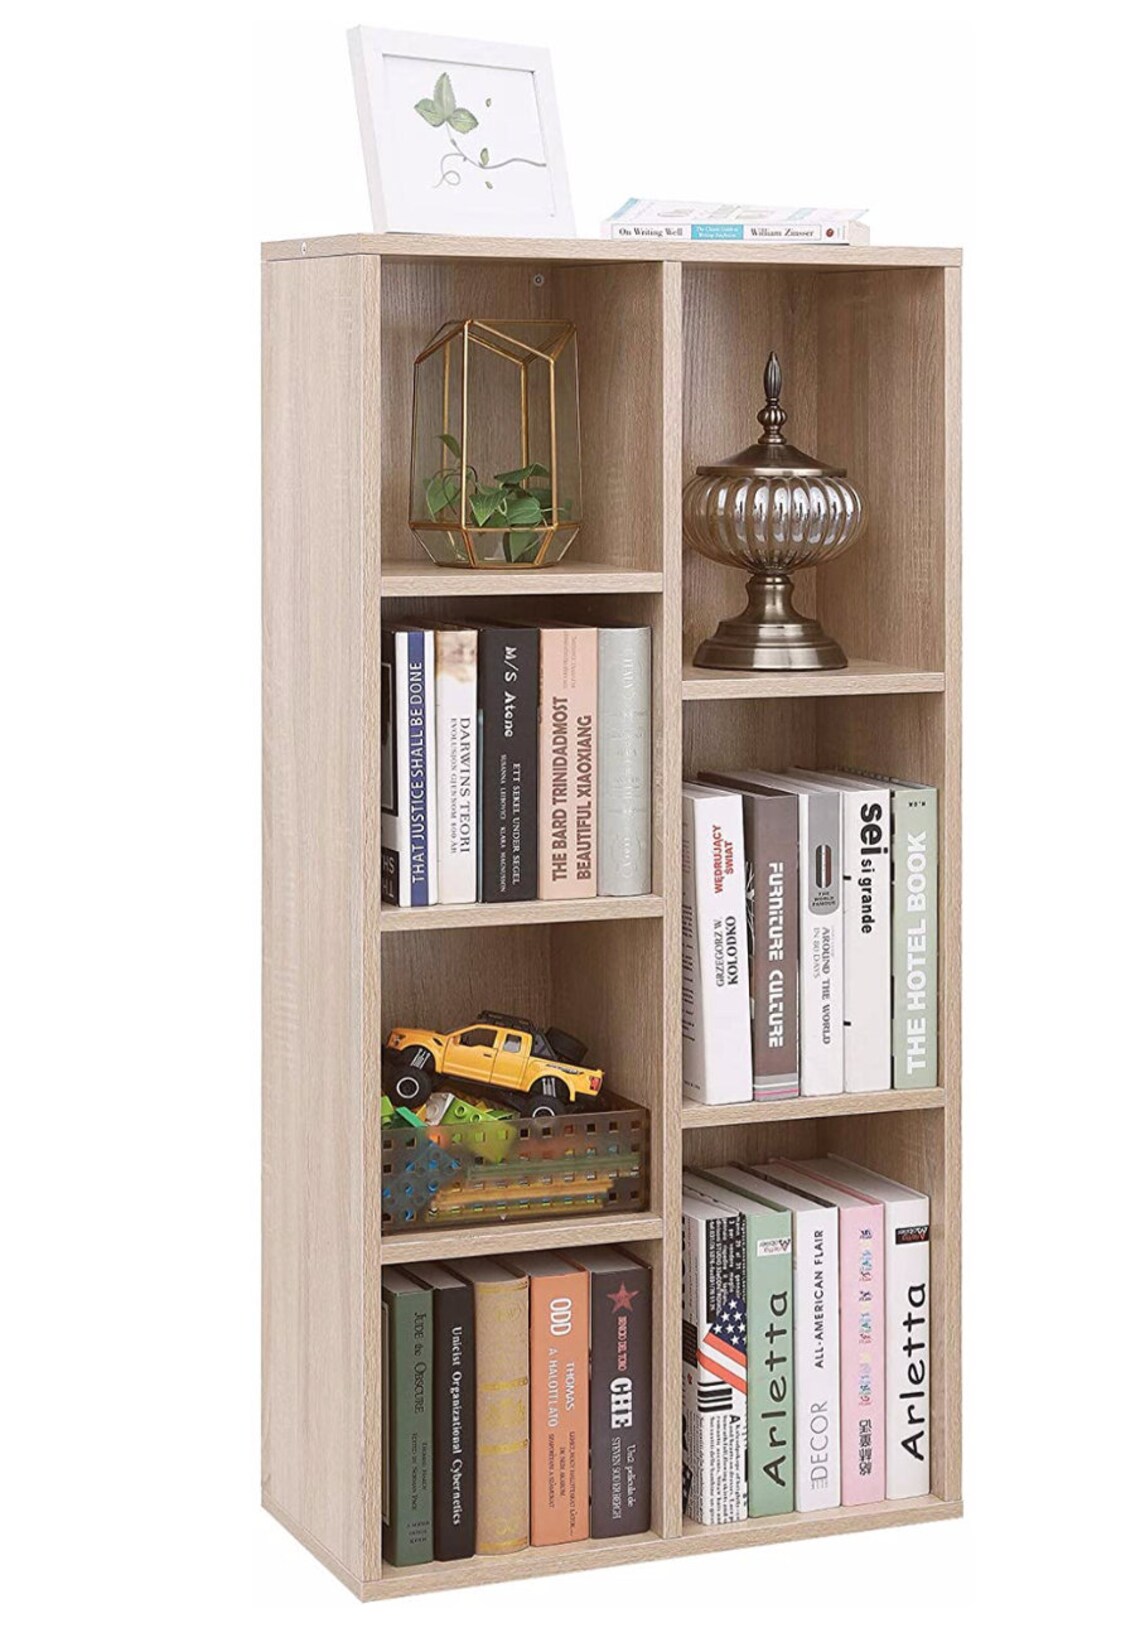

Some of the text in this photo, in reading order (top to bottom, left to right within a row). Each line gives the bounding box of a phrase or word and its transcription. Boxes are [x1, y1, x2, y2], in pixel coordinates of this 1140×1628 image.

[618, 228, 684, 238] On Writing Well
[750, 228, 782, 237] William
[784, 228, 814, 237] Zinsser
[504, 646, 519, 738] M/S Atene
[410, 662, 424, 884] THAT JUSTICE SHALL BE DONE
[460, 718, 470, 853] DARWINS TEORI
[552, 696, 568, 882] THE BARD TRINIDADMOST
[576, 714, 592, 880] BEAUTIFUL XIAOXIANG
[512, 763, 520, 886] ETT SEKEL UNDER SEGEL
[858, 802, 888, 934] sei si grande
[714, 932, 724, 988] GRZEGORZ
[769, 862, 783, 1048] FURNITURE CULTURE
[812, 927, 820, 938] IN
[812, 954, 820, 978] DAYS
[906, 830, 926, 1075] THE HOTEL BOOK
[822, 926, 830, 1045] AROUND THE WORLD
[550, 1297, 572, 1336] ODD
[814, 1230, 824, 1368] ALL-AMERICAN FLAIR
[414, 1343, 425, 1356] the
[414, 1362, 427, 1414] OBSCURE
[549, 1347, 558, 1356] A
[566, 1361, 575, 1410] THOMAS
[760, 1291, 788, 1488] Arletta
[898, 1282, 926, 1462] Arletta
[450, 1326, 462, 1525] Unicist Organizational Cybernetics
[610, 1377, 633, 1429] CHE
[730, 1414, 741, 1424] A
[809, 1400, 829, 1484] DECOR
[612, 1436, 622, 1466] STEVEN
